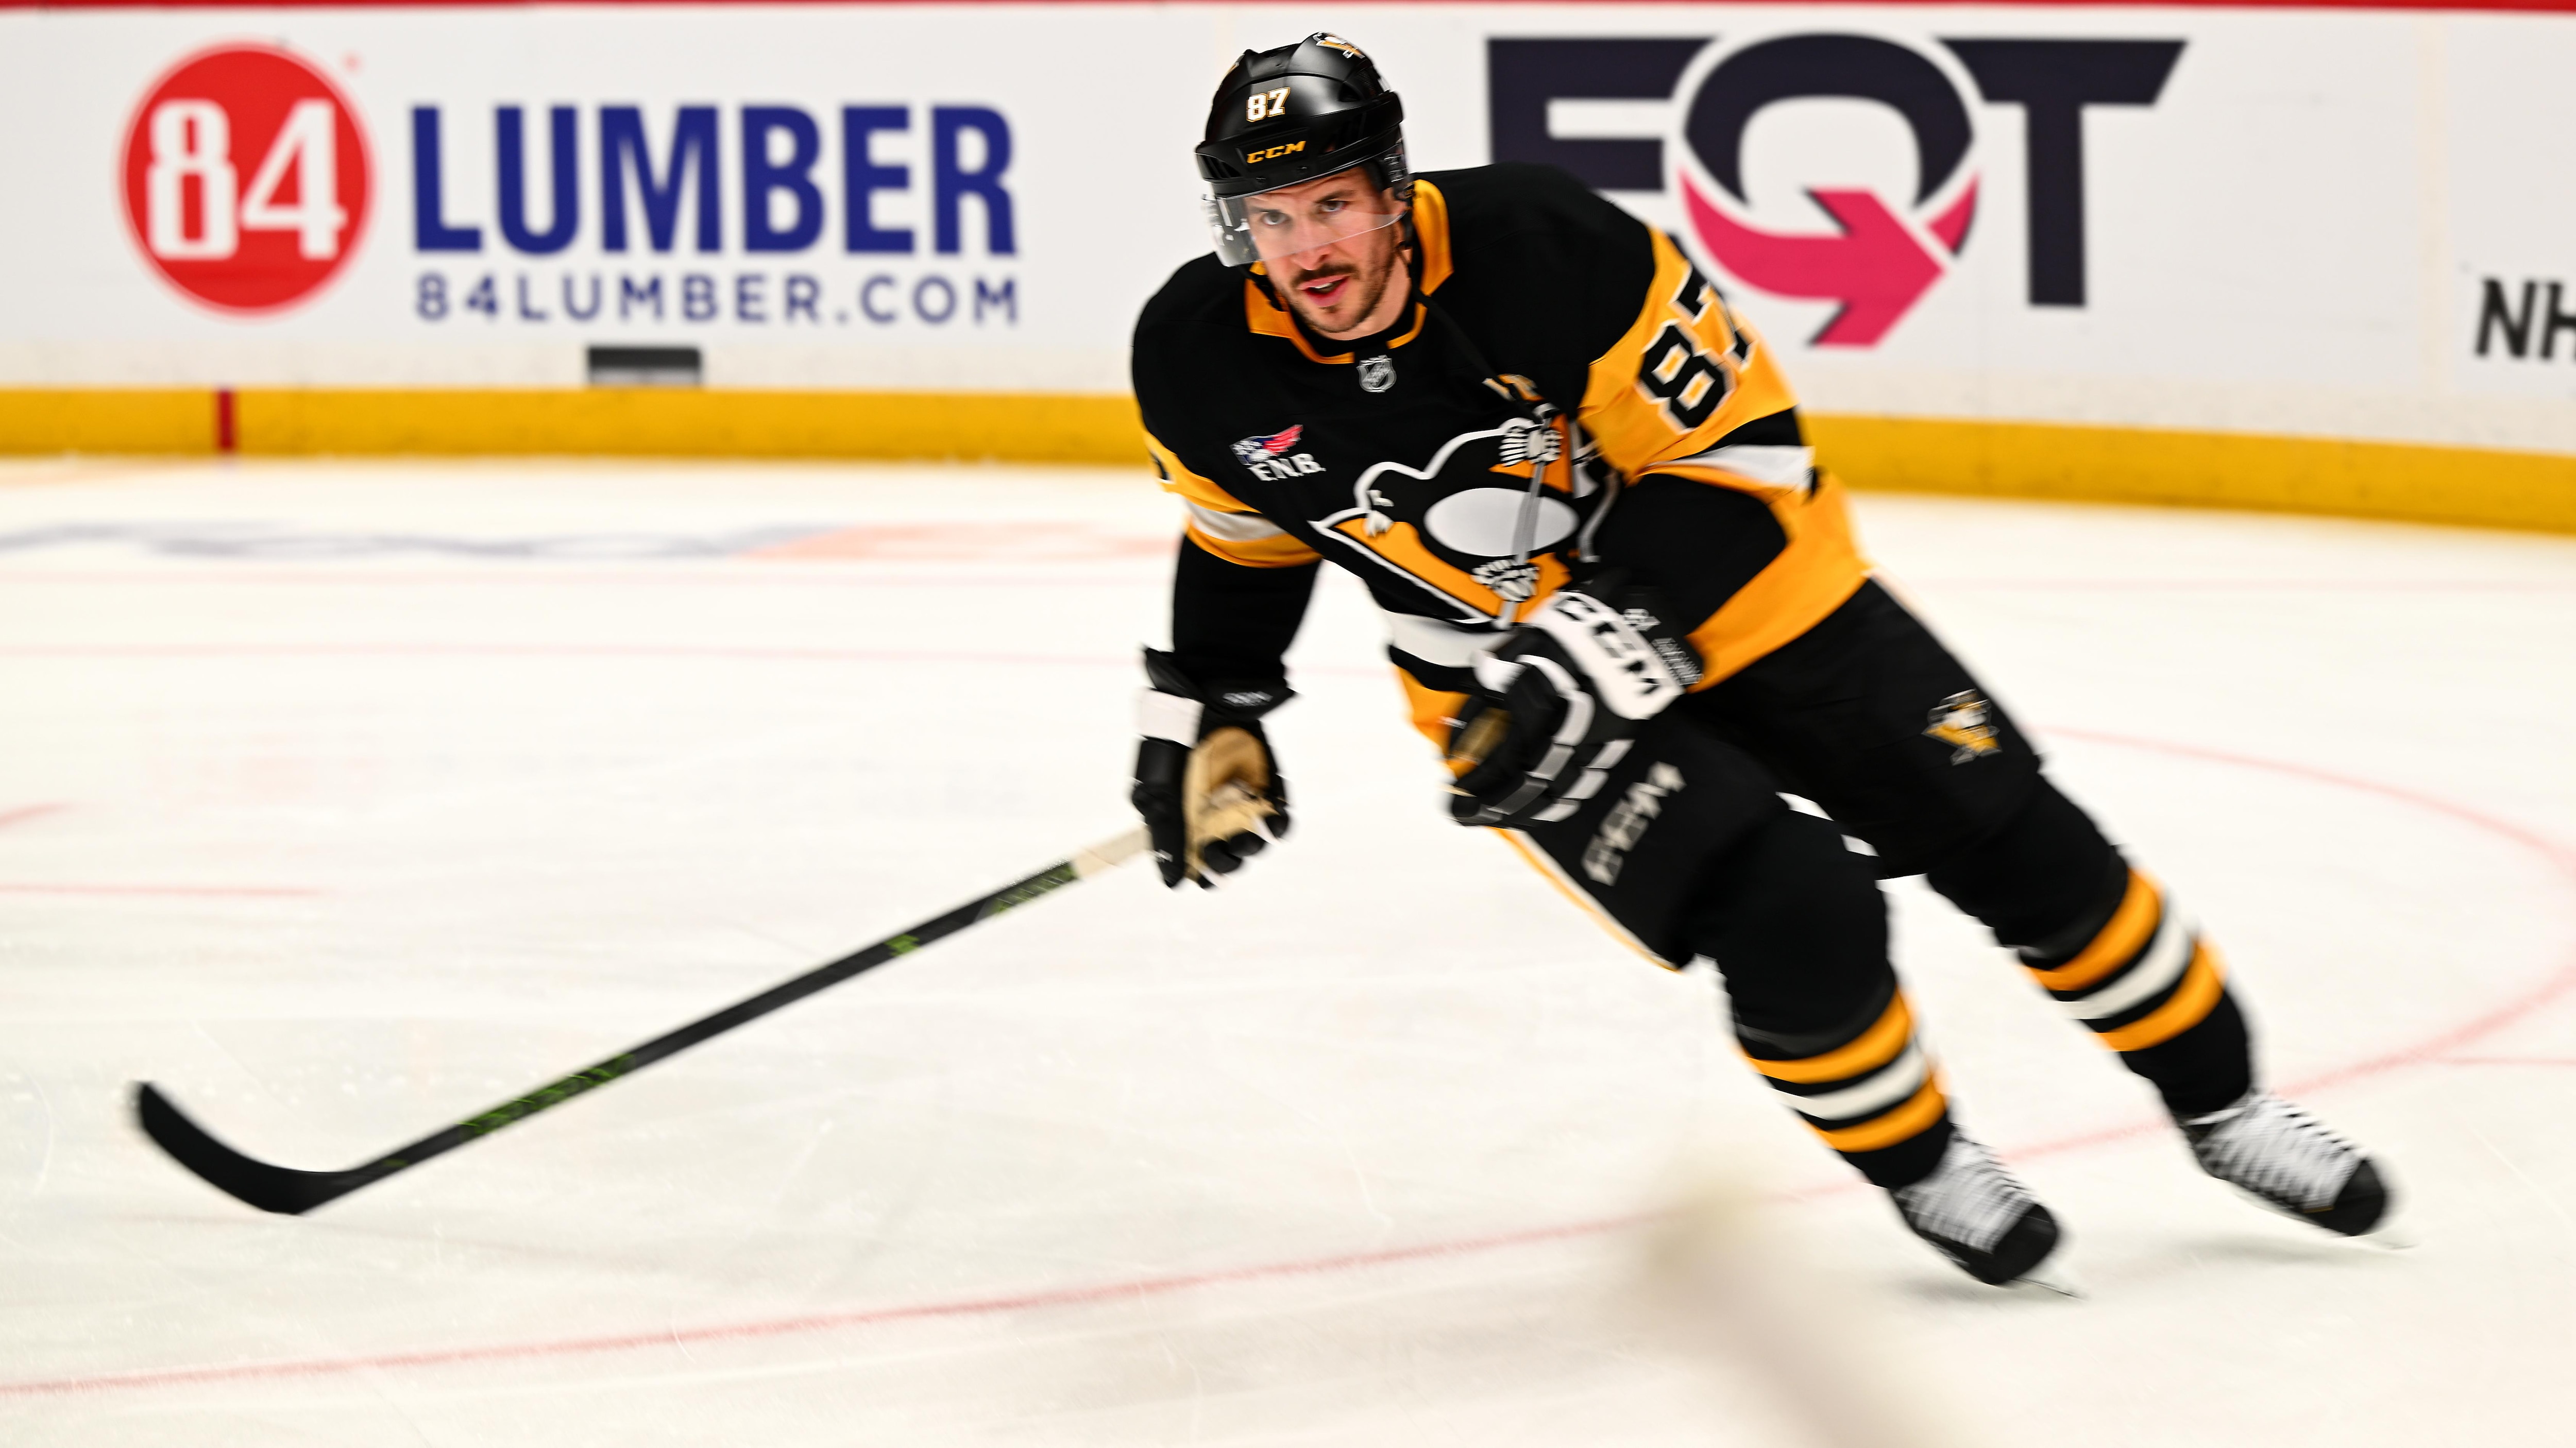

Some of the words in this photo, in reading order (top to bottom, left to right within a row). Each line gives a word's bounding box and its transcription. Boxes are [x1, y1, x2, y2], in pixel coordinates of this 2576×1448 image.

[1246, 87, 1291, 122] 87
[146, 97, 349, 261] 84
[411, 105, 1018, 256] LUMBER
[1246, 140, 1307, 164] CCM
[1486, 33, 2187, 349] EQT
[415, 271, 1019, 326] 84LUMBER.COM
